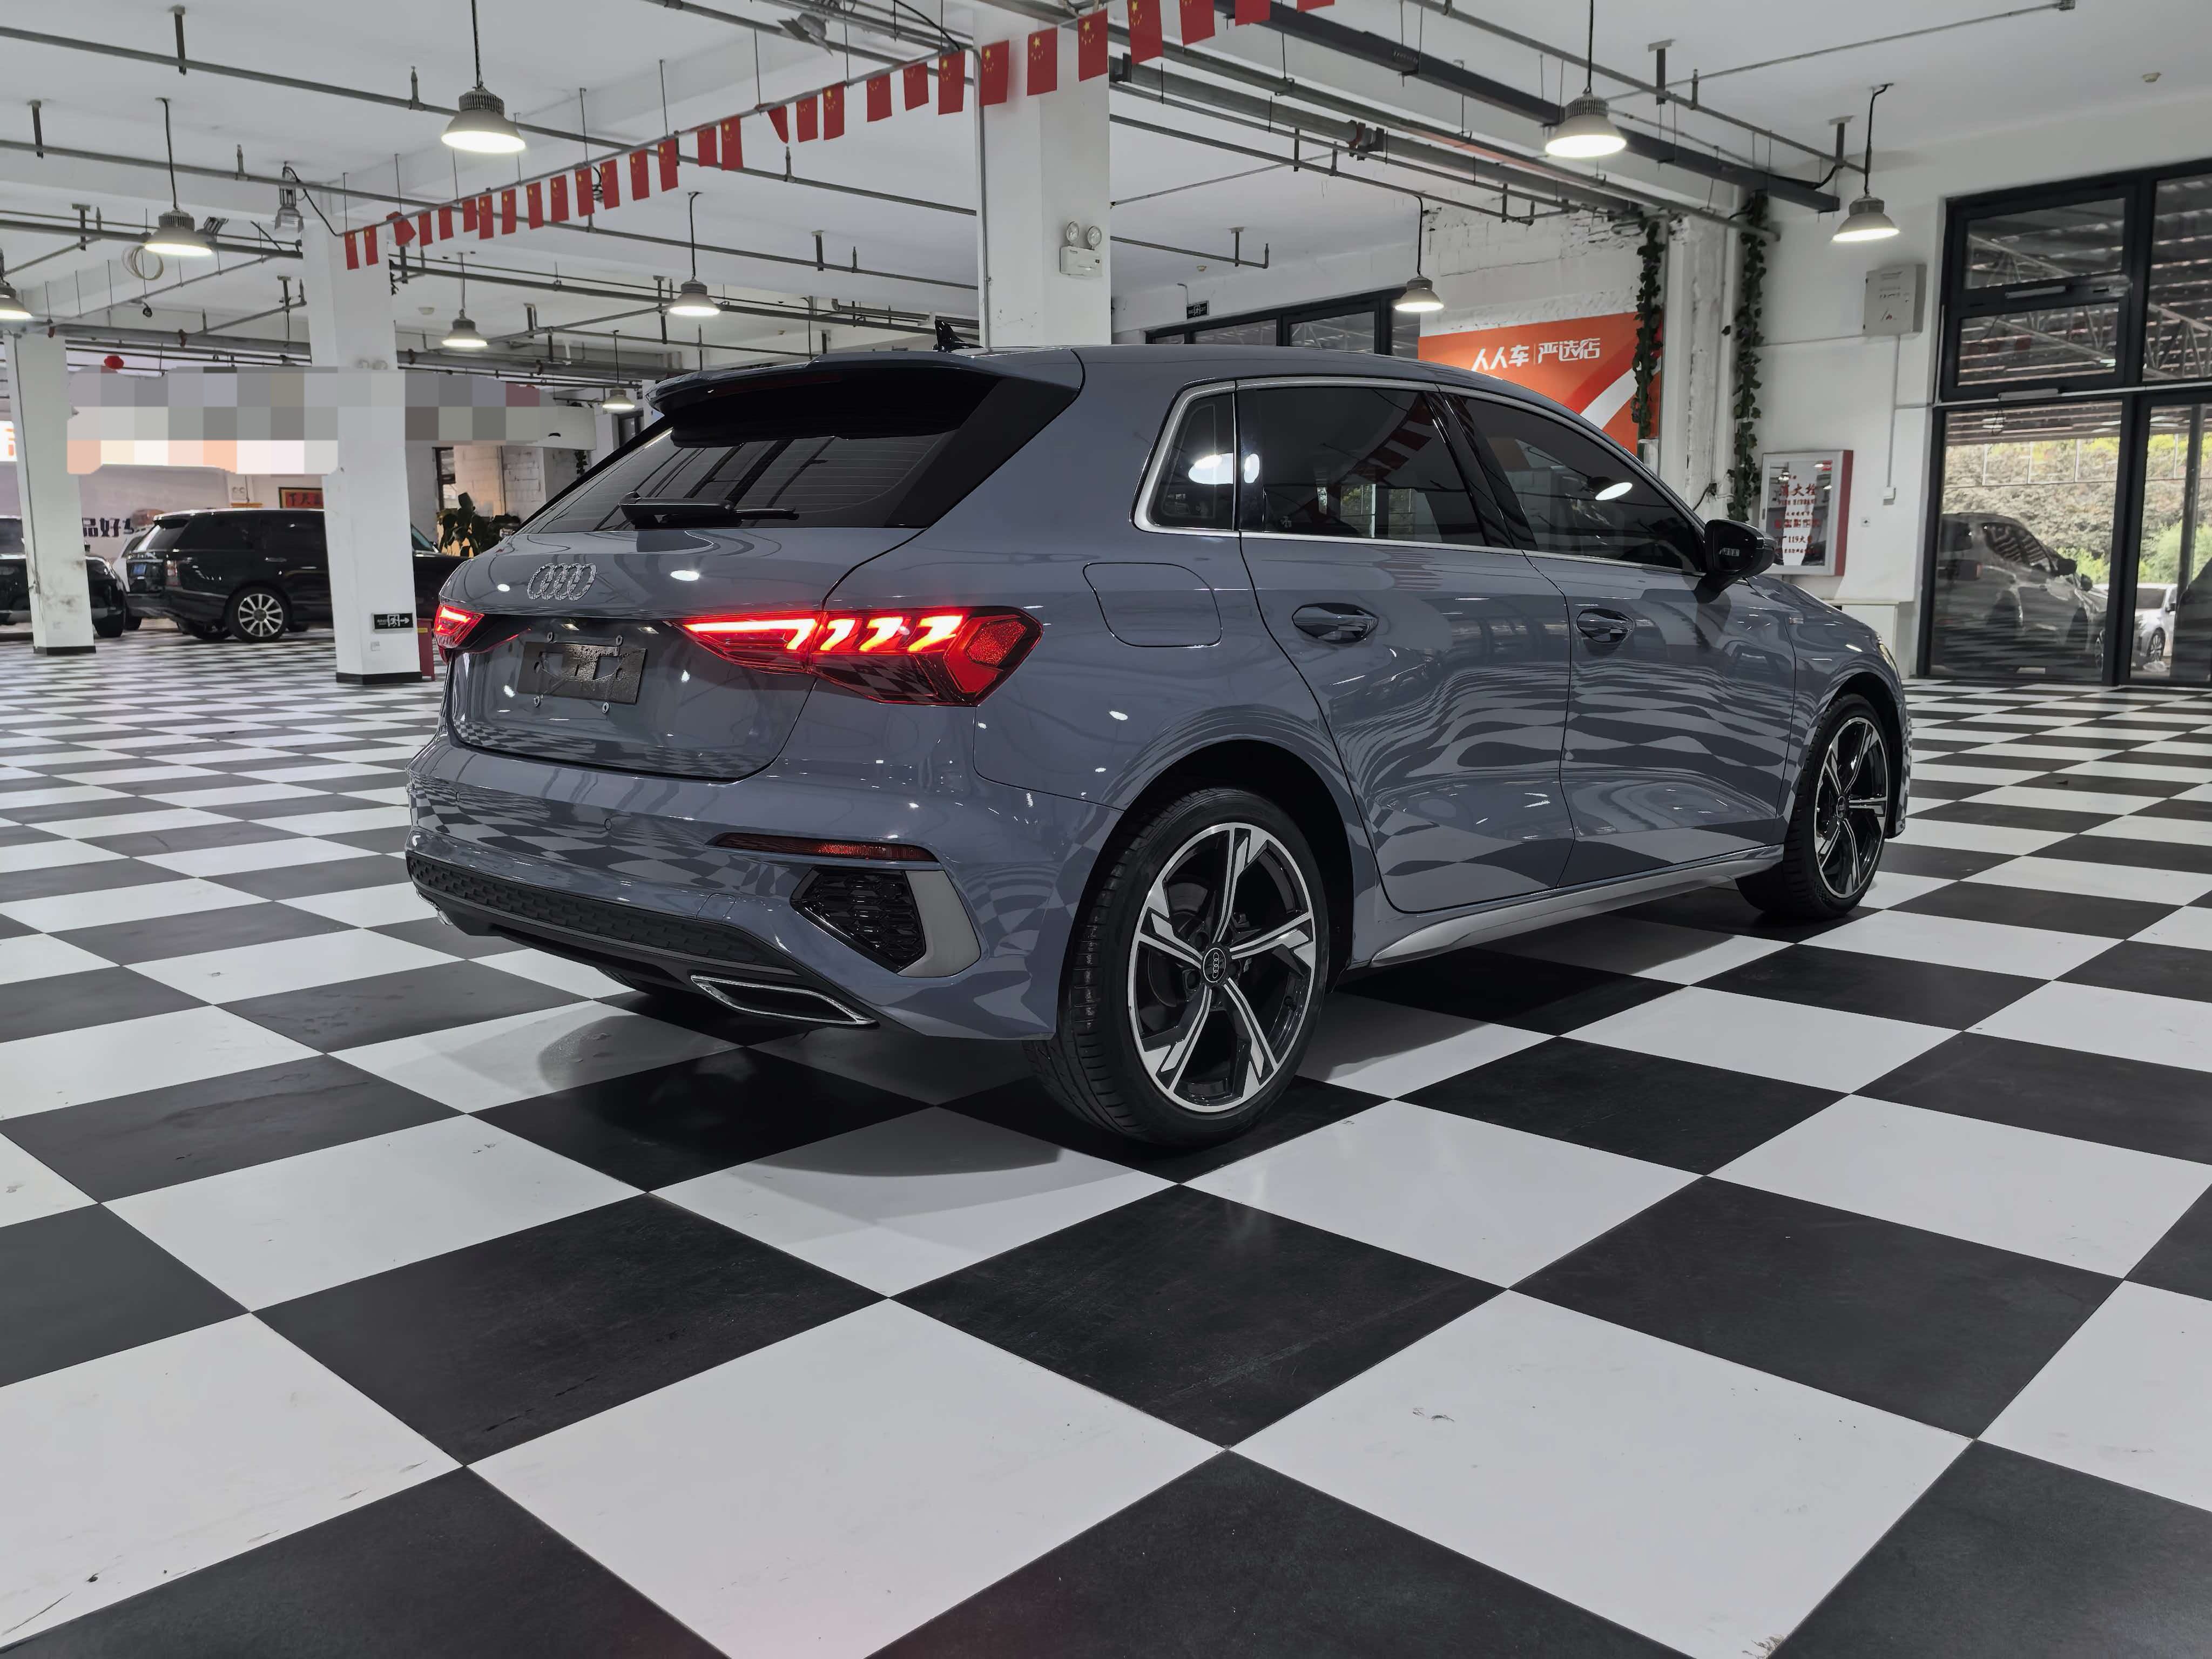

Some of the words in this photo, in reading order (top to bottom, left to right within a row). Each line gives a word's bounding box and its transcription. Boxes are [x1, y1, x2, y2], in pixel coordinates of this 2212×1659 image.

[1471, 344, 1529, 372] 人人车
[1537, 338, 1601, 364] 严选店
